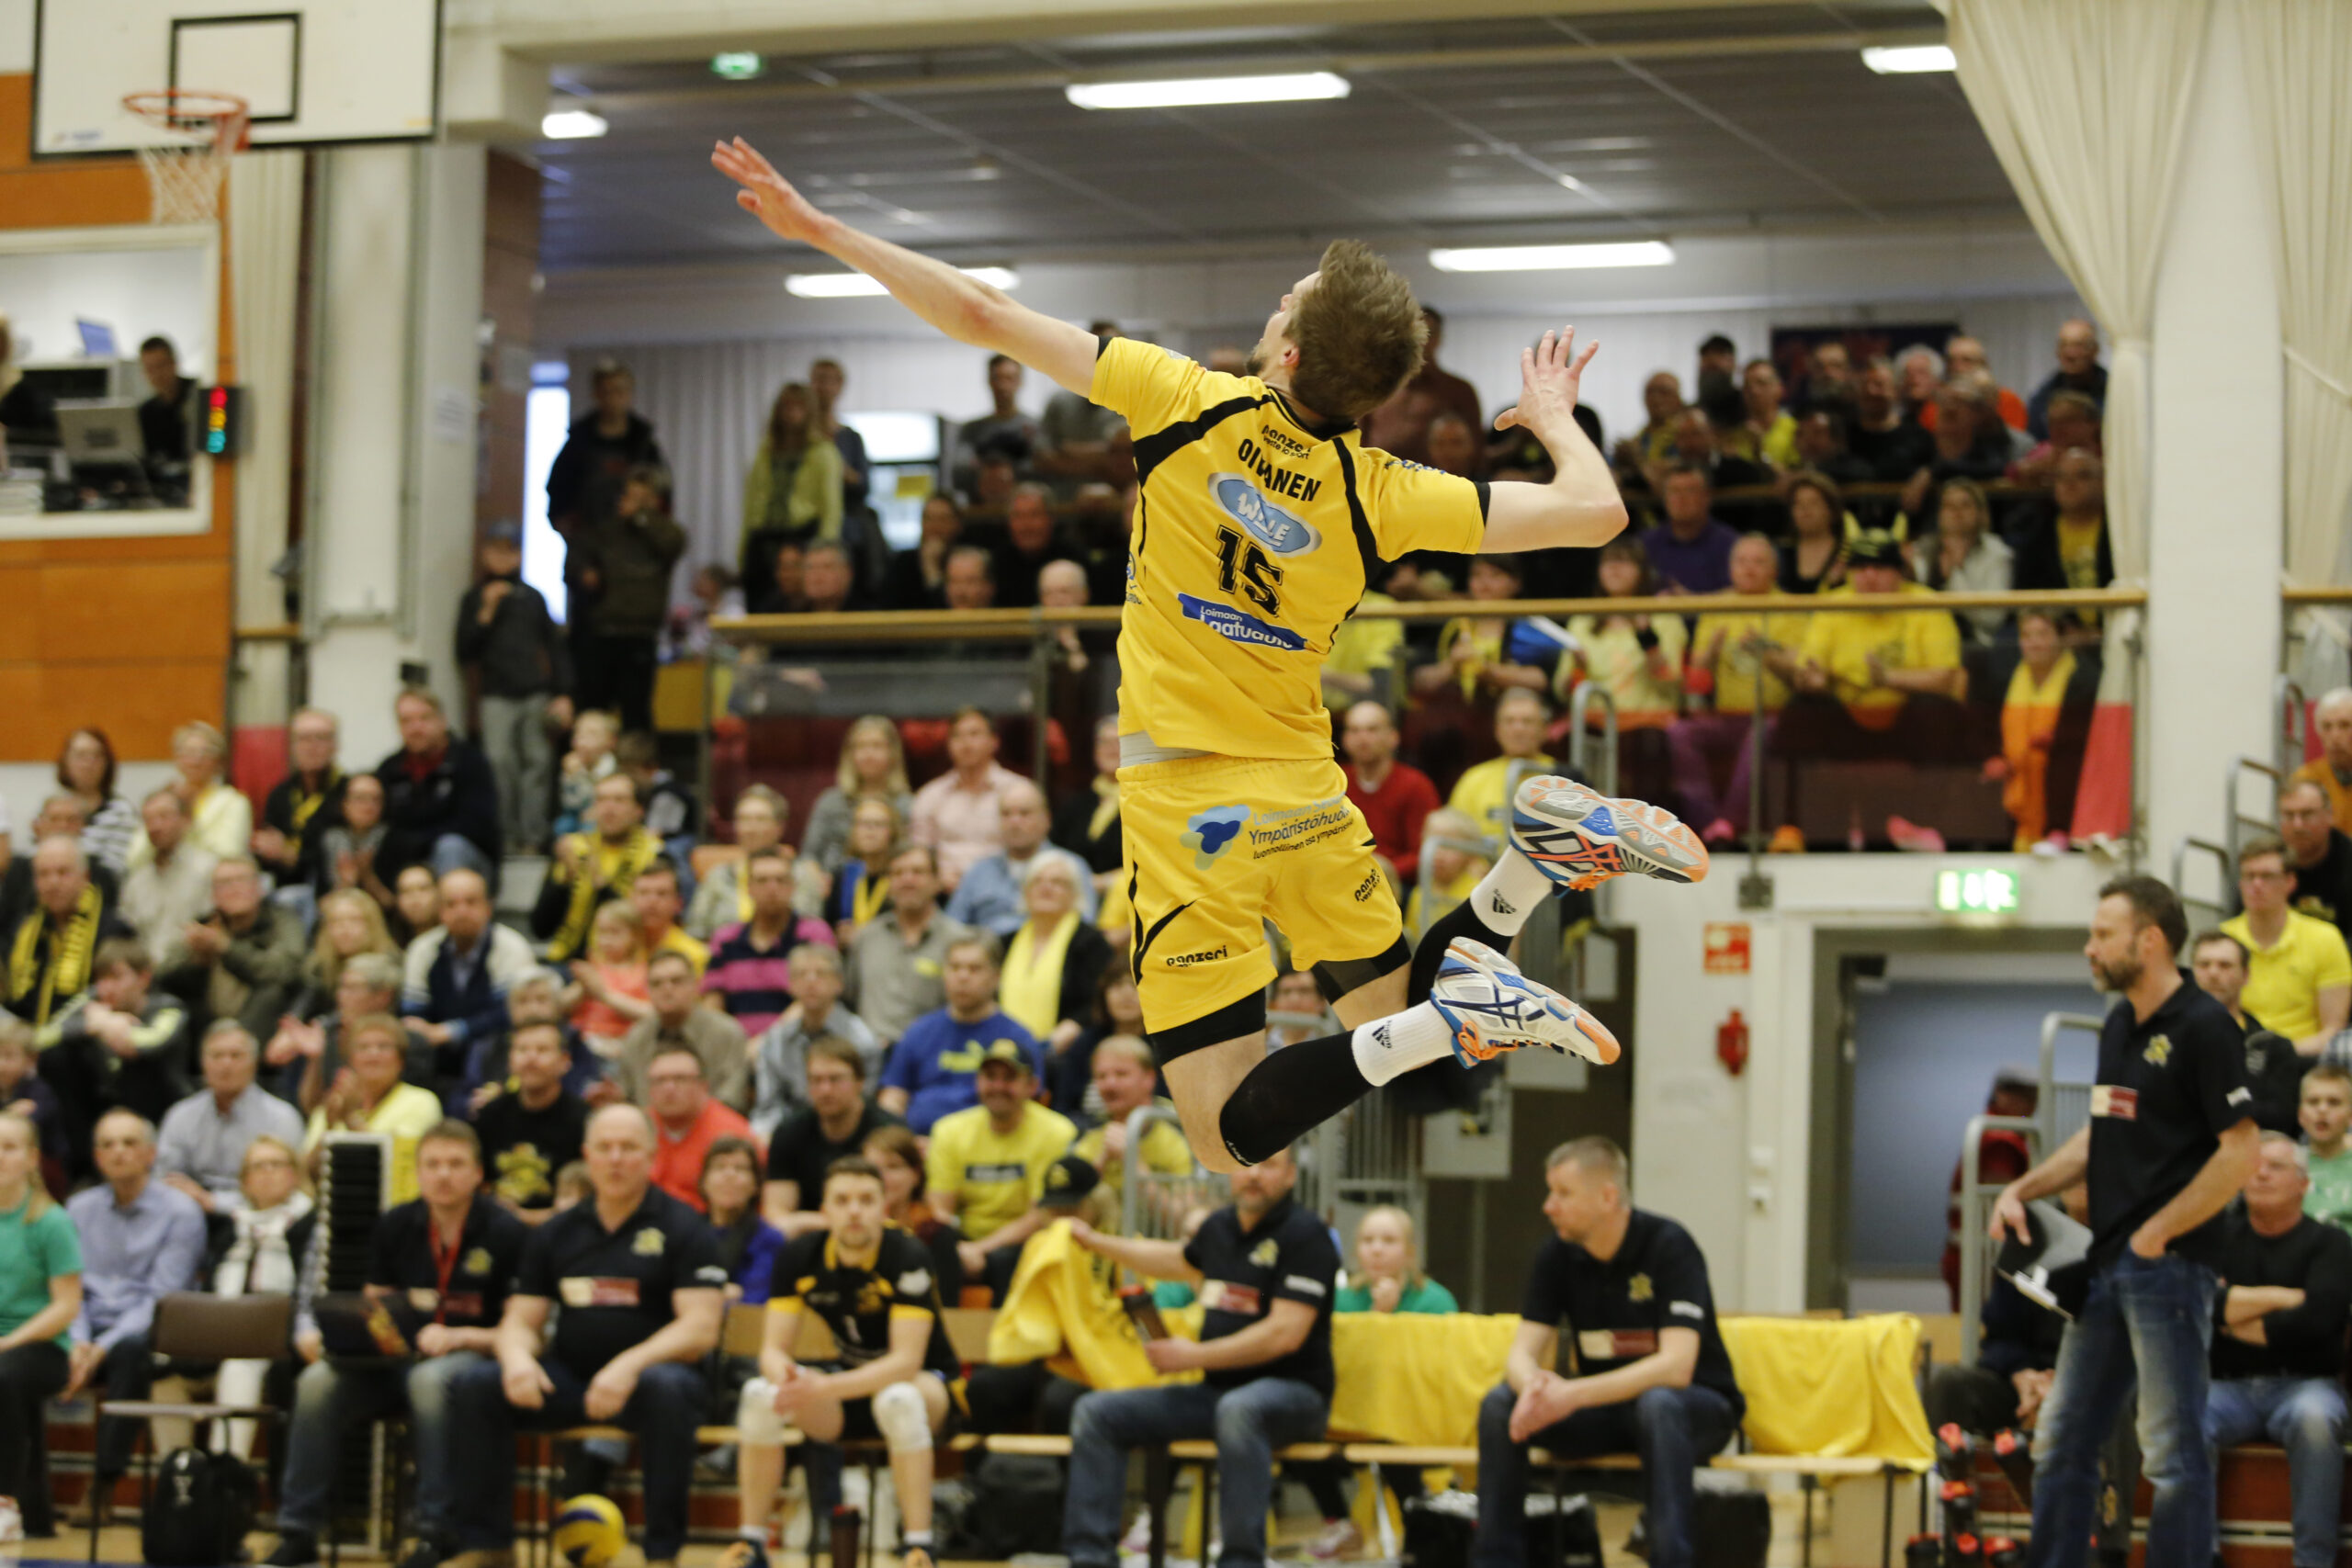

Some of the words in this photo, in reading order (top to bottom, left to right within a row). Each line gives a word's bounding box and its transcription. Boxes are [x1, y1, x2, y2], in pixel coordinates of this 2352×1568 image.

[1216, 525, 1284, 618] 15
[1200, 606, 1243, 622] Loimaan
[1166, 944, 1228, 967] panzeri
